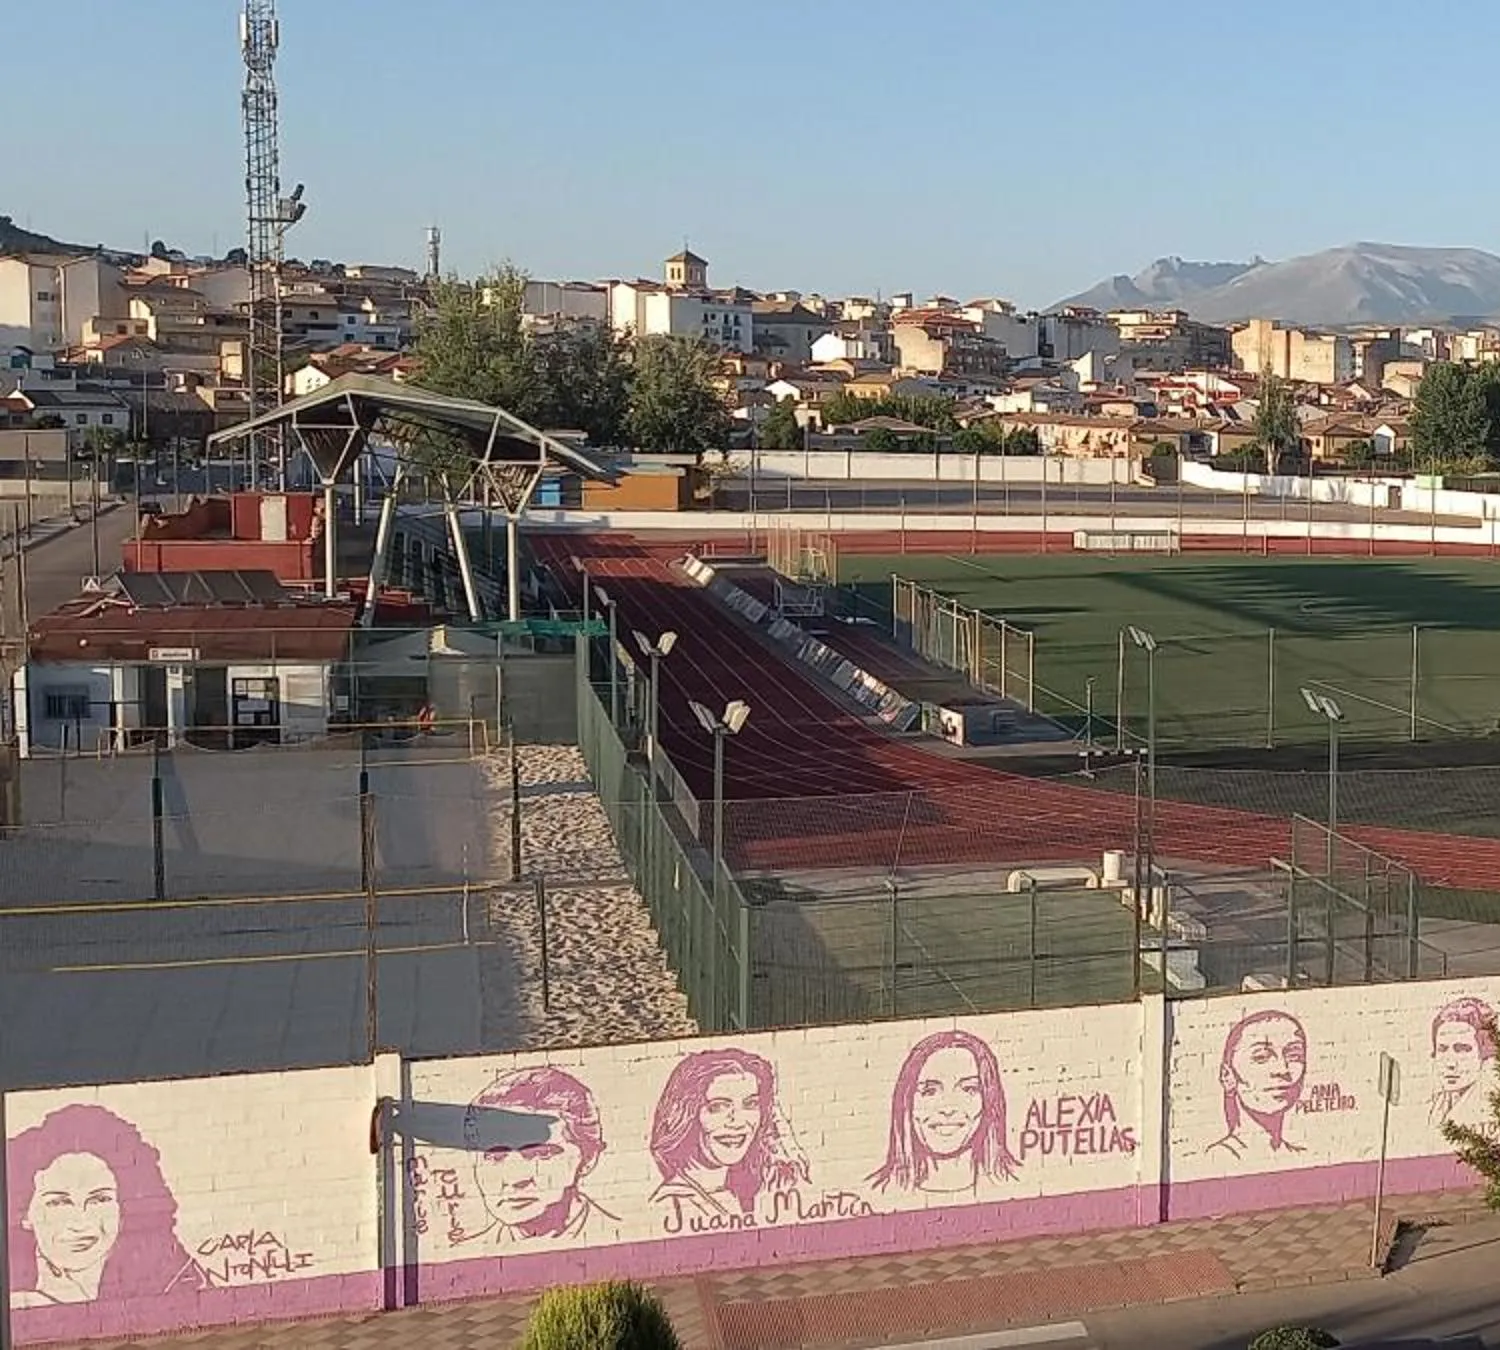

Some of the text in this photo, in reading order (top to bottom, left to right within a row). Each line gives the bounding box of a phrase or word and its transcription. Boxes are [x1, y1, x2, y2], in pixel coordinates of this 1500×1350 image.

[1311, 1083, 1341, 1099] ANA
[1025, 1091, 1117, 1129] ALEXIA
[1019, 1125, 1137, 1161] PUTELLAS
[663, 1194, 758, 1233] Juana
[197, 1228, 284, 1256] CARLA
